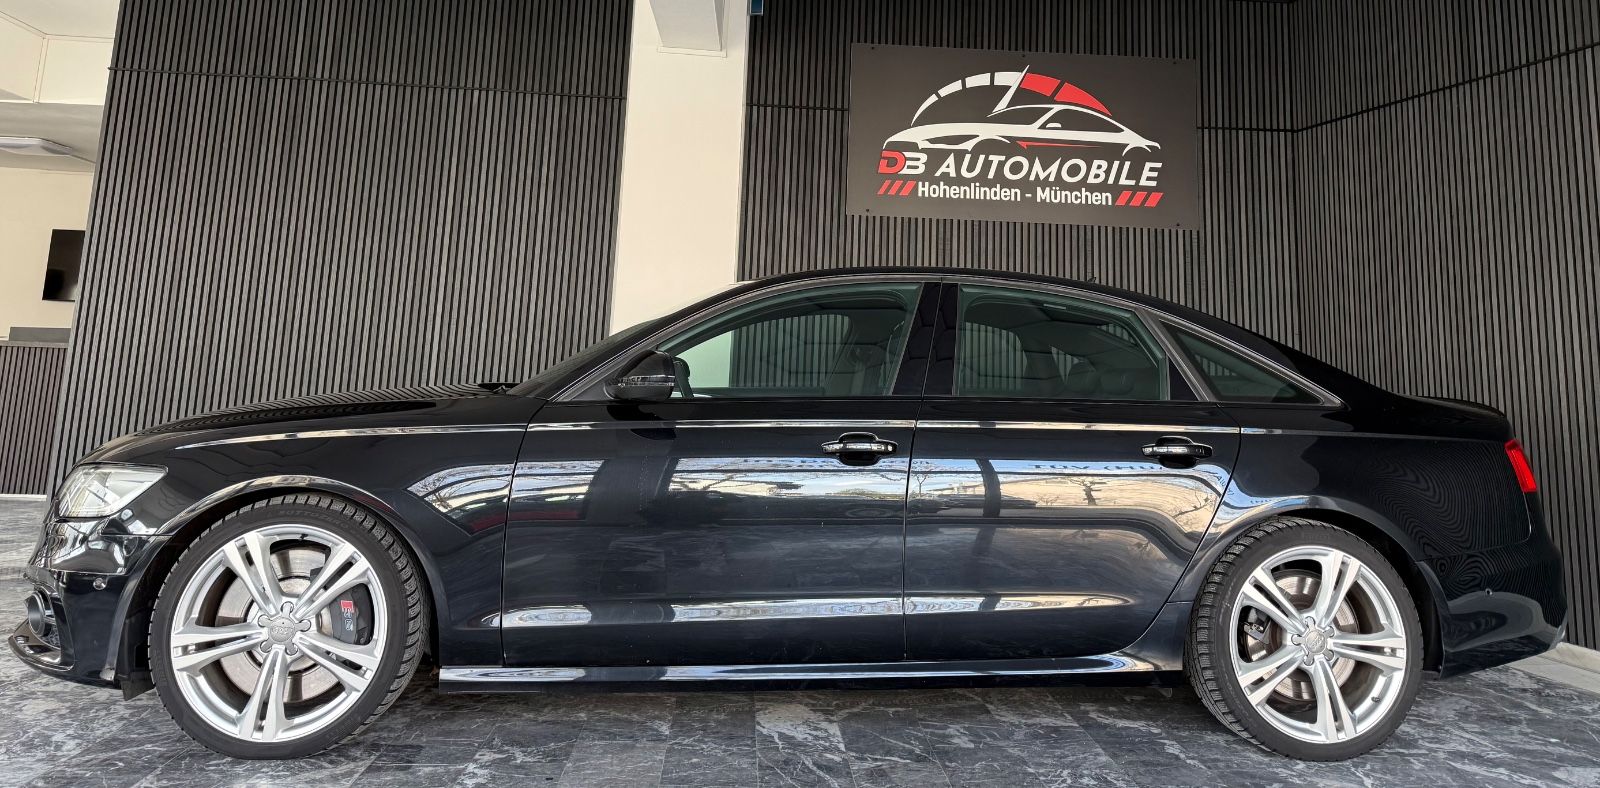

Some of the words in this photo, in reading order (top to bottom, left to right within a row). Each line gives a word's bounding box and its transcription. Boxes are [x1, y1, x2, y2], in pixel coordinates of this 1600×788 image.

[877, 150, 928, 175] DB
[934, 152, 1163, 187] AUTOMOBILE
[917, 181, 1021, 202] Hohenlinden
[1036, 185, 1113, 206] München
